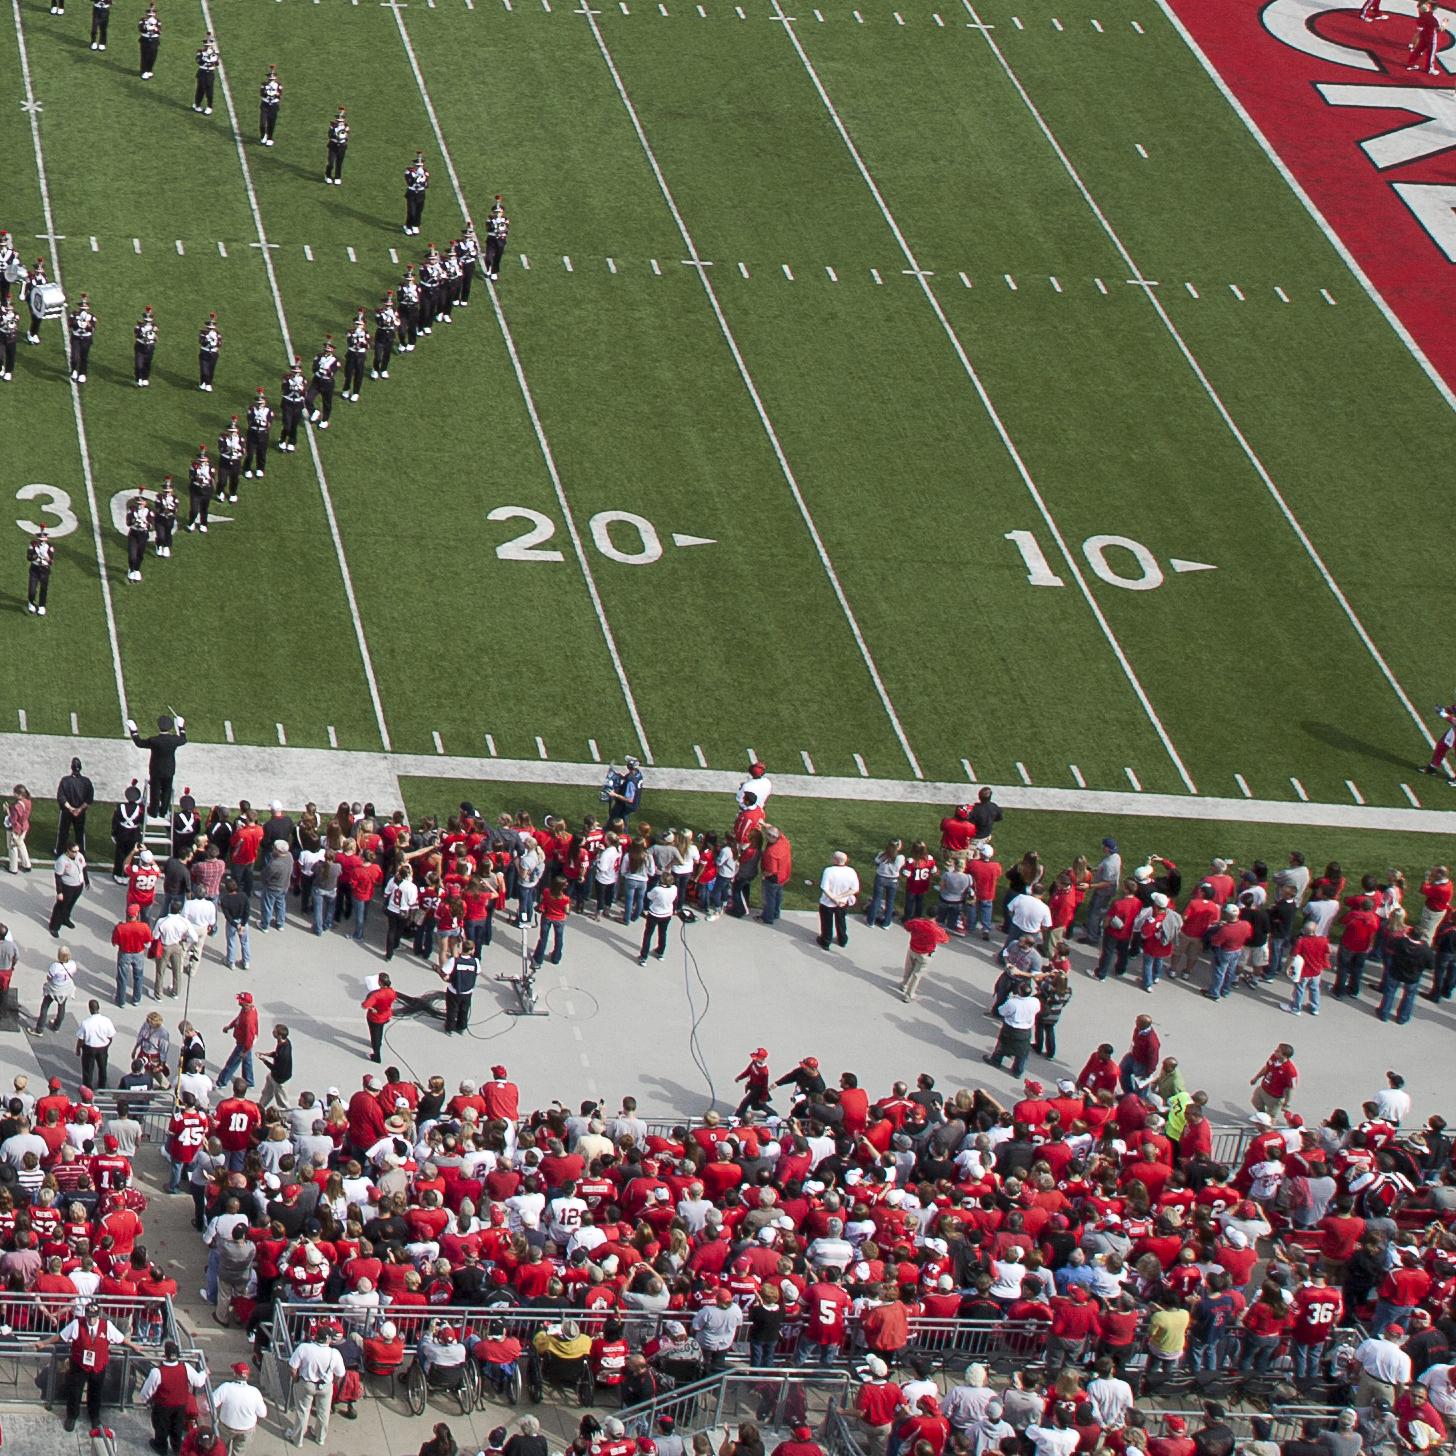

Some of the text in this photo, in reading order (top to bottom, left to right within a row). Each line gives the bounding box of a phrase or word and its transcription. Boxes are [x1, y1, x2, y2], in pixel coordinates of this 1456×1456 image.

[486, 505, 663, 565] 20
[1004, 529, 1164, 590] 10
[913, 867, 930, 882] 16
[229, 1112, 248, 1132] 10
[178, 1127, 204, 1146] 45
[1211, 1199, 1227, 1218] 2
[819, 1299, 837, 1325] 5
[1307, 1302, 1334, 1325] 36
